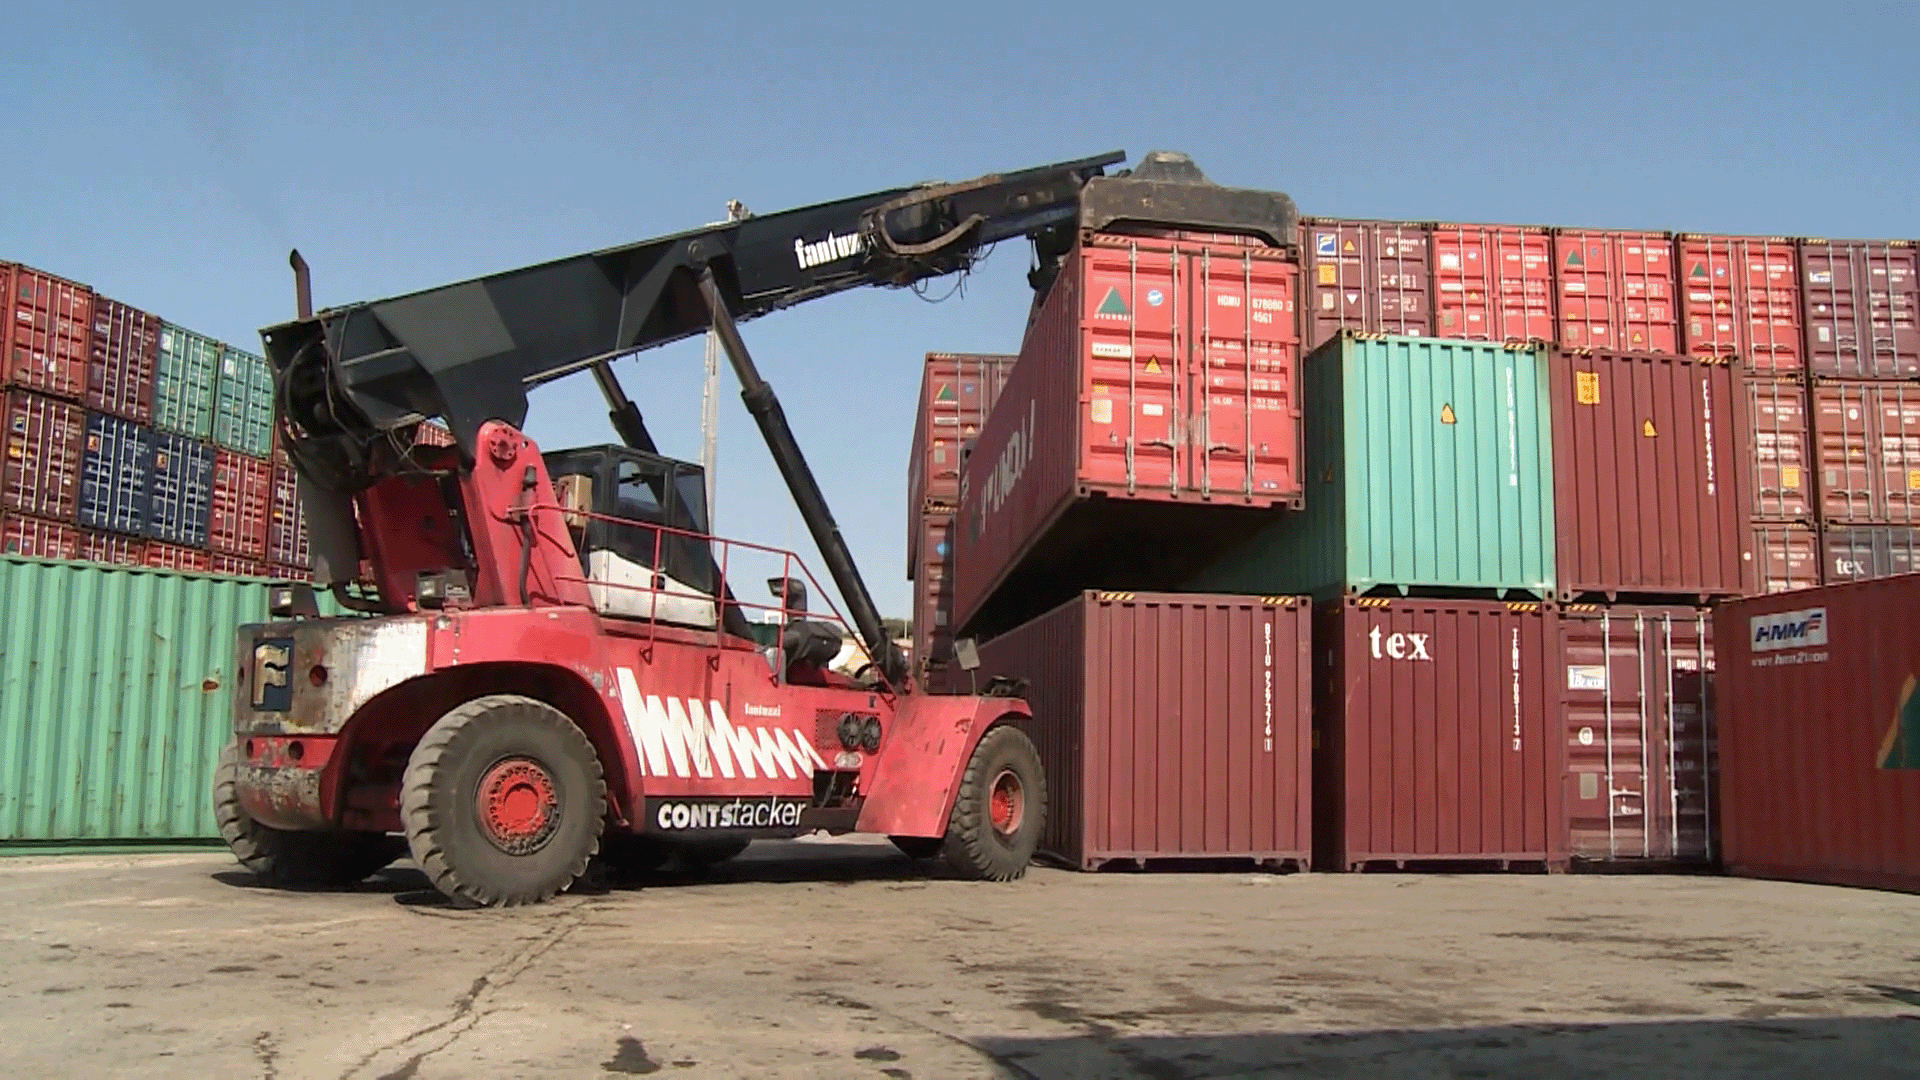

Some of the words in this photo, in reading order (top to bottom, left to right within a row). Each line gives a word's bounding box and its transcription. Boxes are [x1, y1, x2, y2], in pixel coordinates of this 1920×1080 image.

[795, 231, 864, 270] fantuz
[1369, 624, 1433, 661] tex
[1754, 615, 1817, 642] HMM
